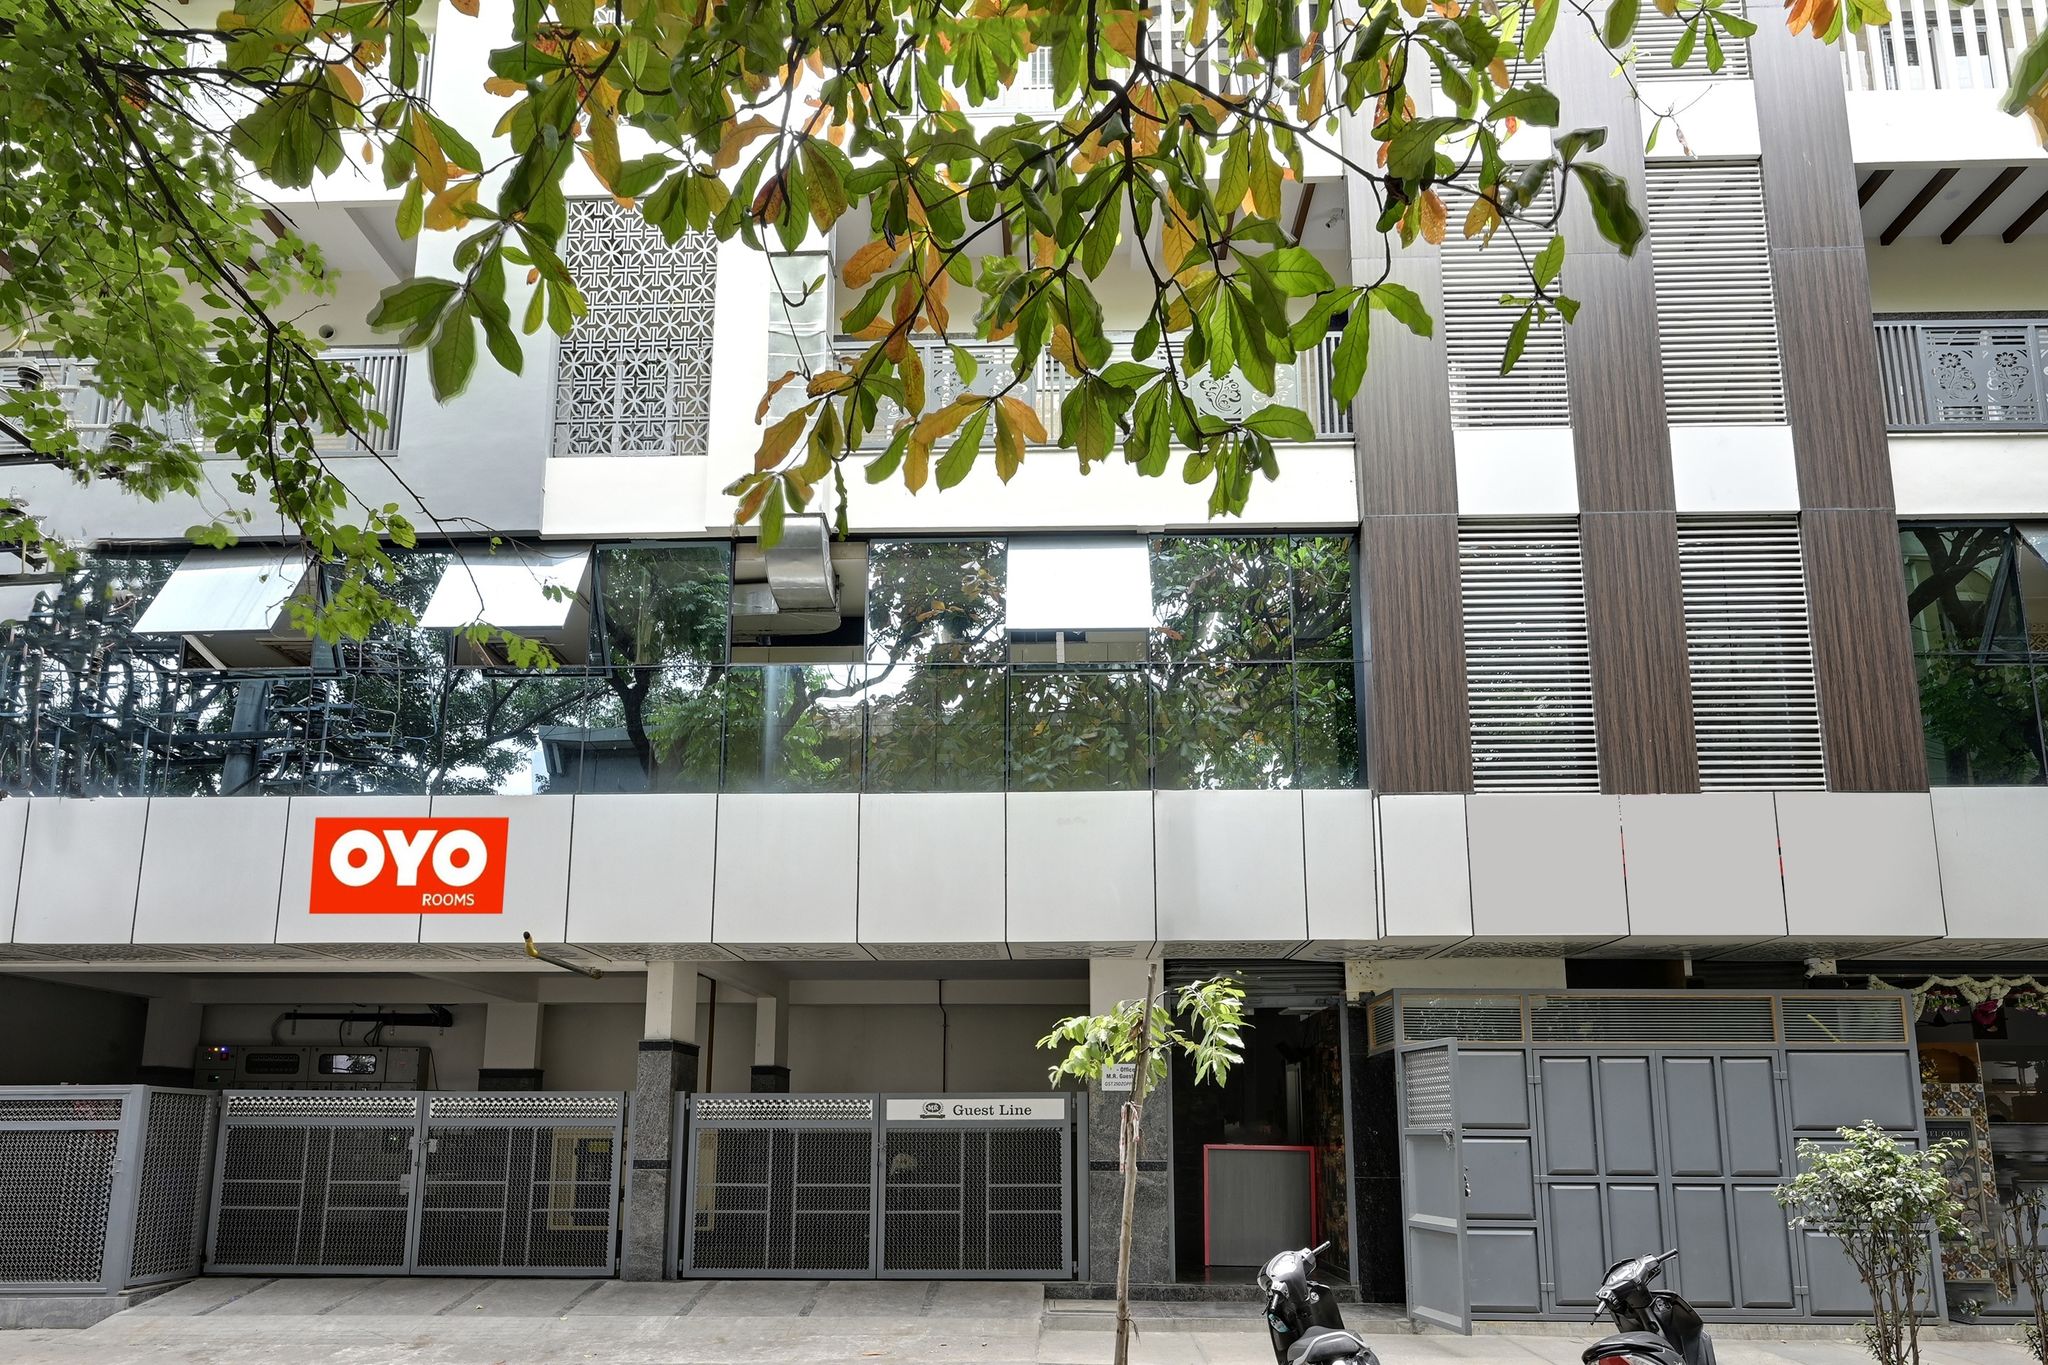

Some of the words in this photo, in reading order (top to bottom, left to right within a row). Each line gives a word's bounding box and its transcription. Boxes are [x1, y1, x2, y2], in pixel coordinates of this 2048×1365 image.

[330, 829, 487, 887] OYO
[422, 893, 475, 906] ROOMS
[952, 1104, 995, 1116] Guest
[999, 1104, 1032, 1116] Line
